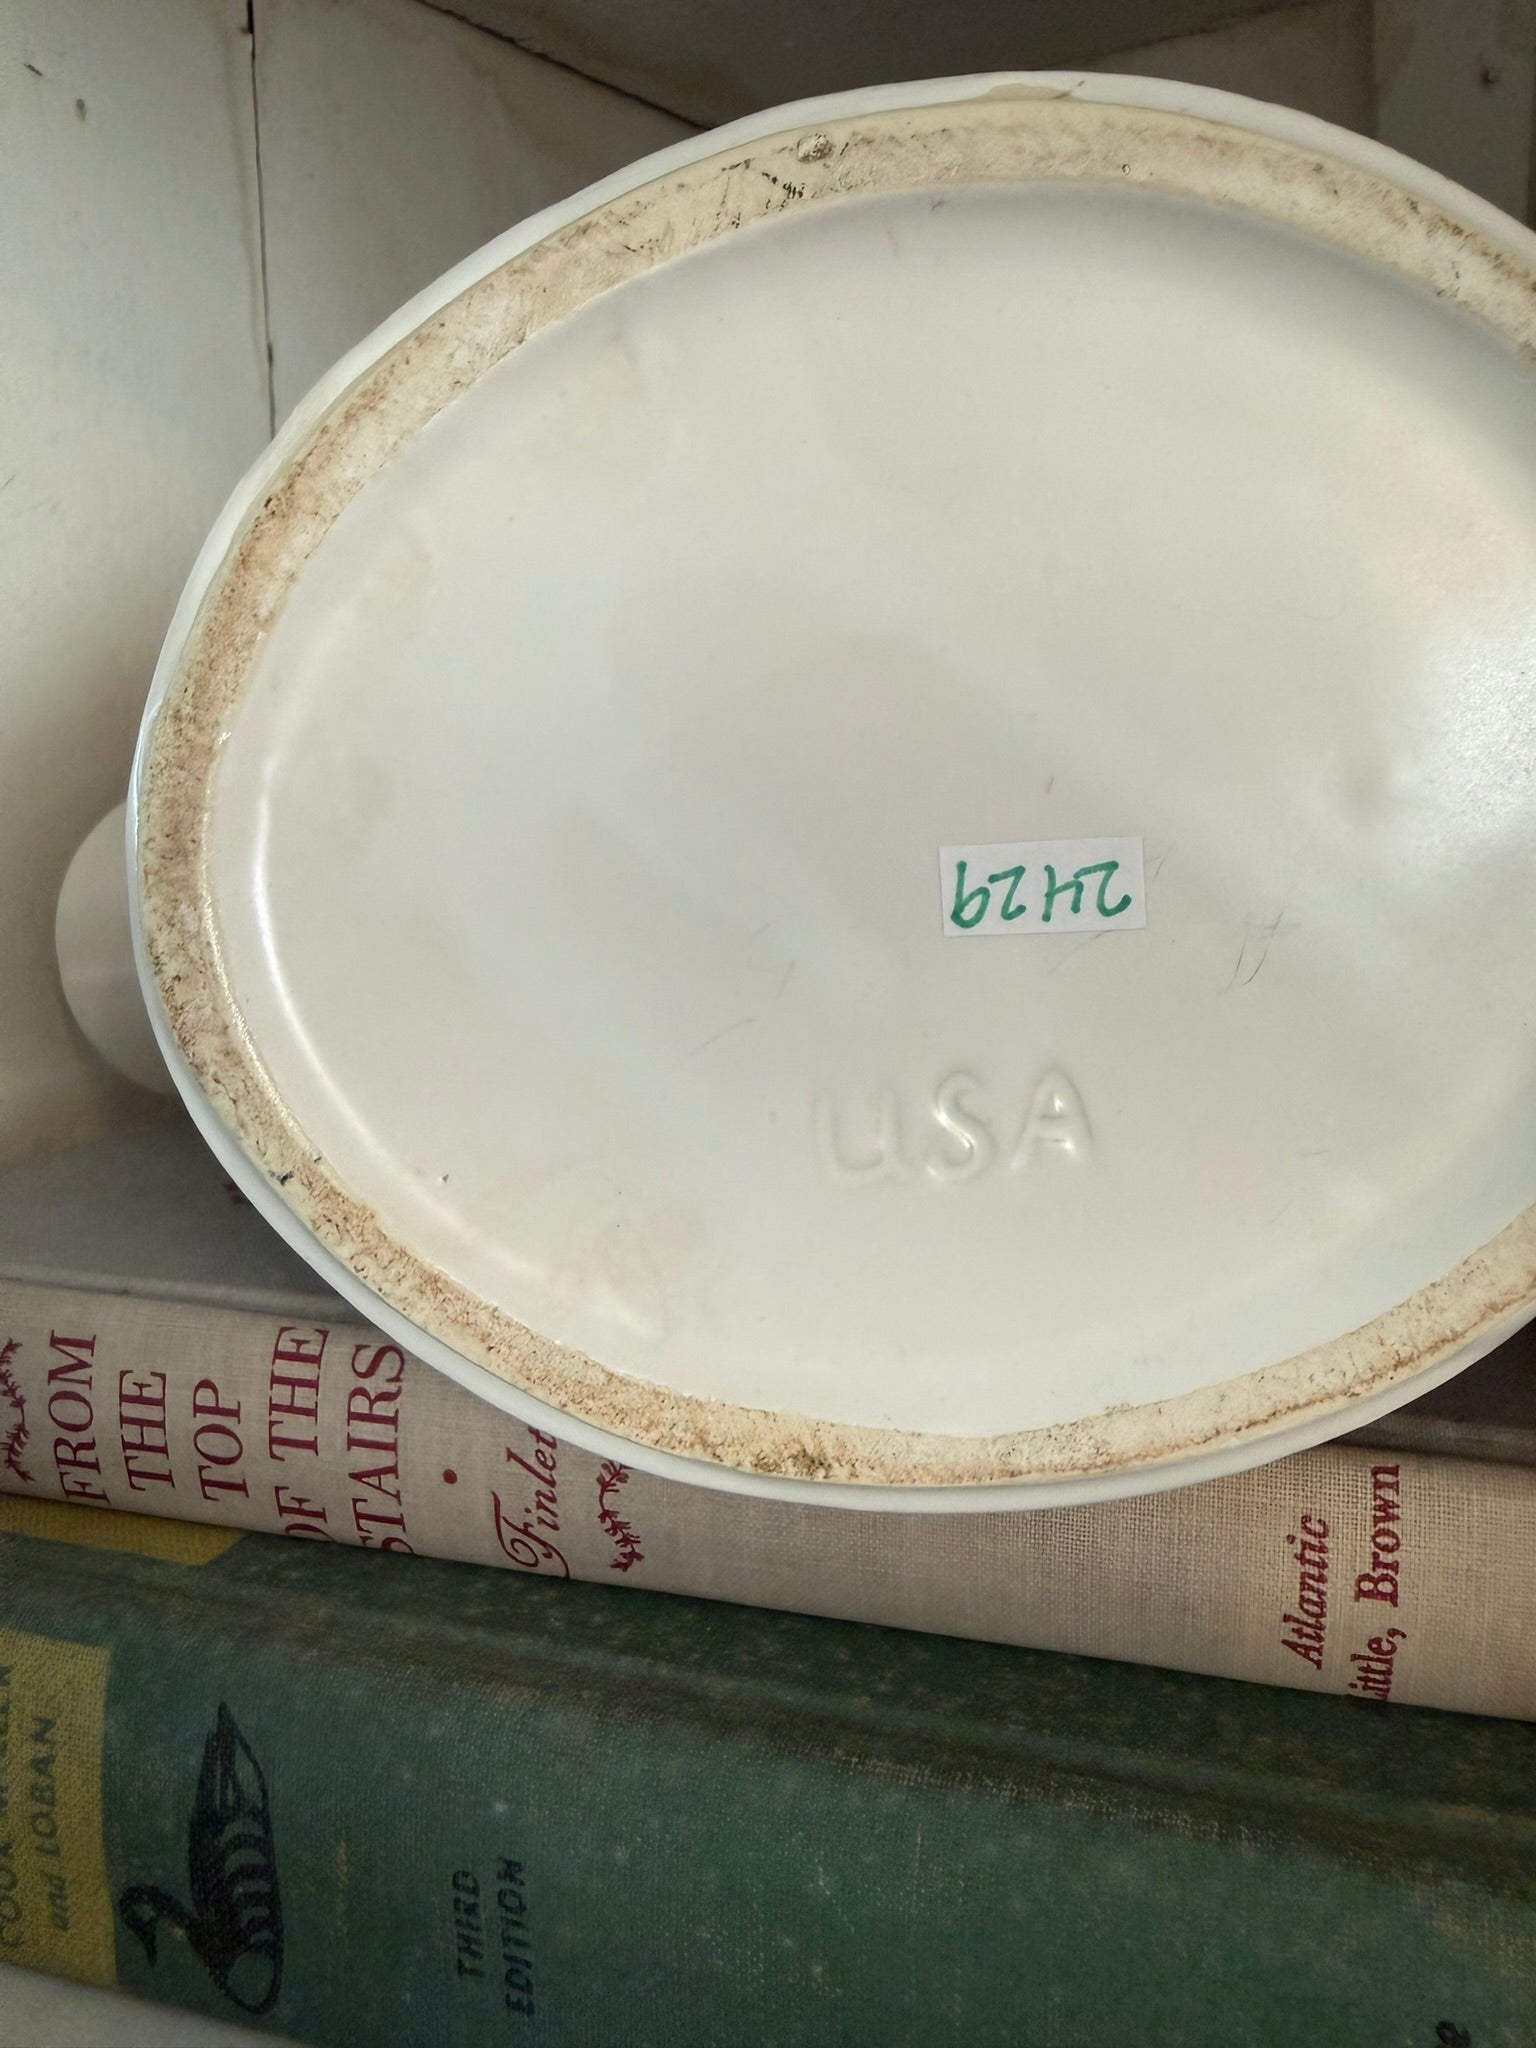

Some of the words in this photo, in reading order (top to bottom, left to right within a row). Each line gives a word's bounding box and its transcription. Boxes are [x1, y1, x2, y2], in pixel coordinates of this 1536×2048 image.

[951, 860, 1132, 928] 2429
[813, 1064, 1094, 1182] USA
[47, 1330, 111, 1504] FROM
[119, 1370, 175, 1491] THE
[193, 1379, 249, 1501] TOP
[268, 1327, 330, 1462] THE
[1281, 1514, 1329, 1670] Atlantic
[1354, 1464, 1400, 1607] Brown
[1348, 1627, 1407, 1701] ittle,
[28, 1714, 61, 1857] LOBAN
[40, 1870, 69, 1931] and
[452, 1870, 485, 1978] THIRD
[497, 1856, 535, 2017] EDITION
